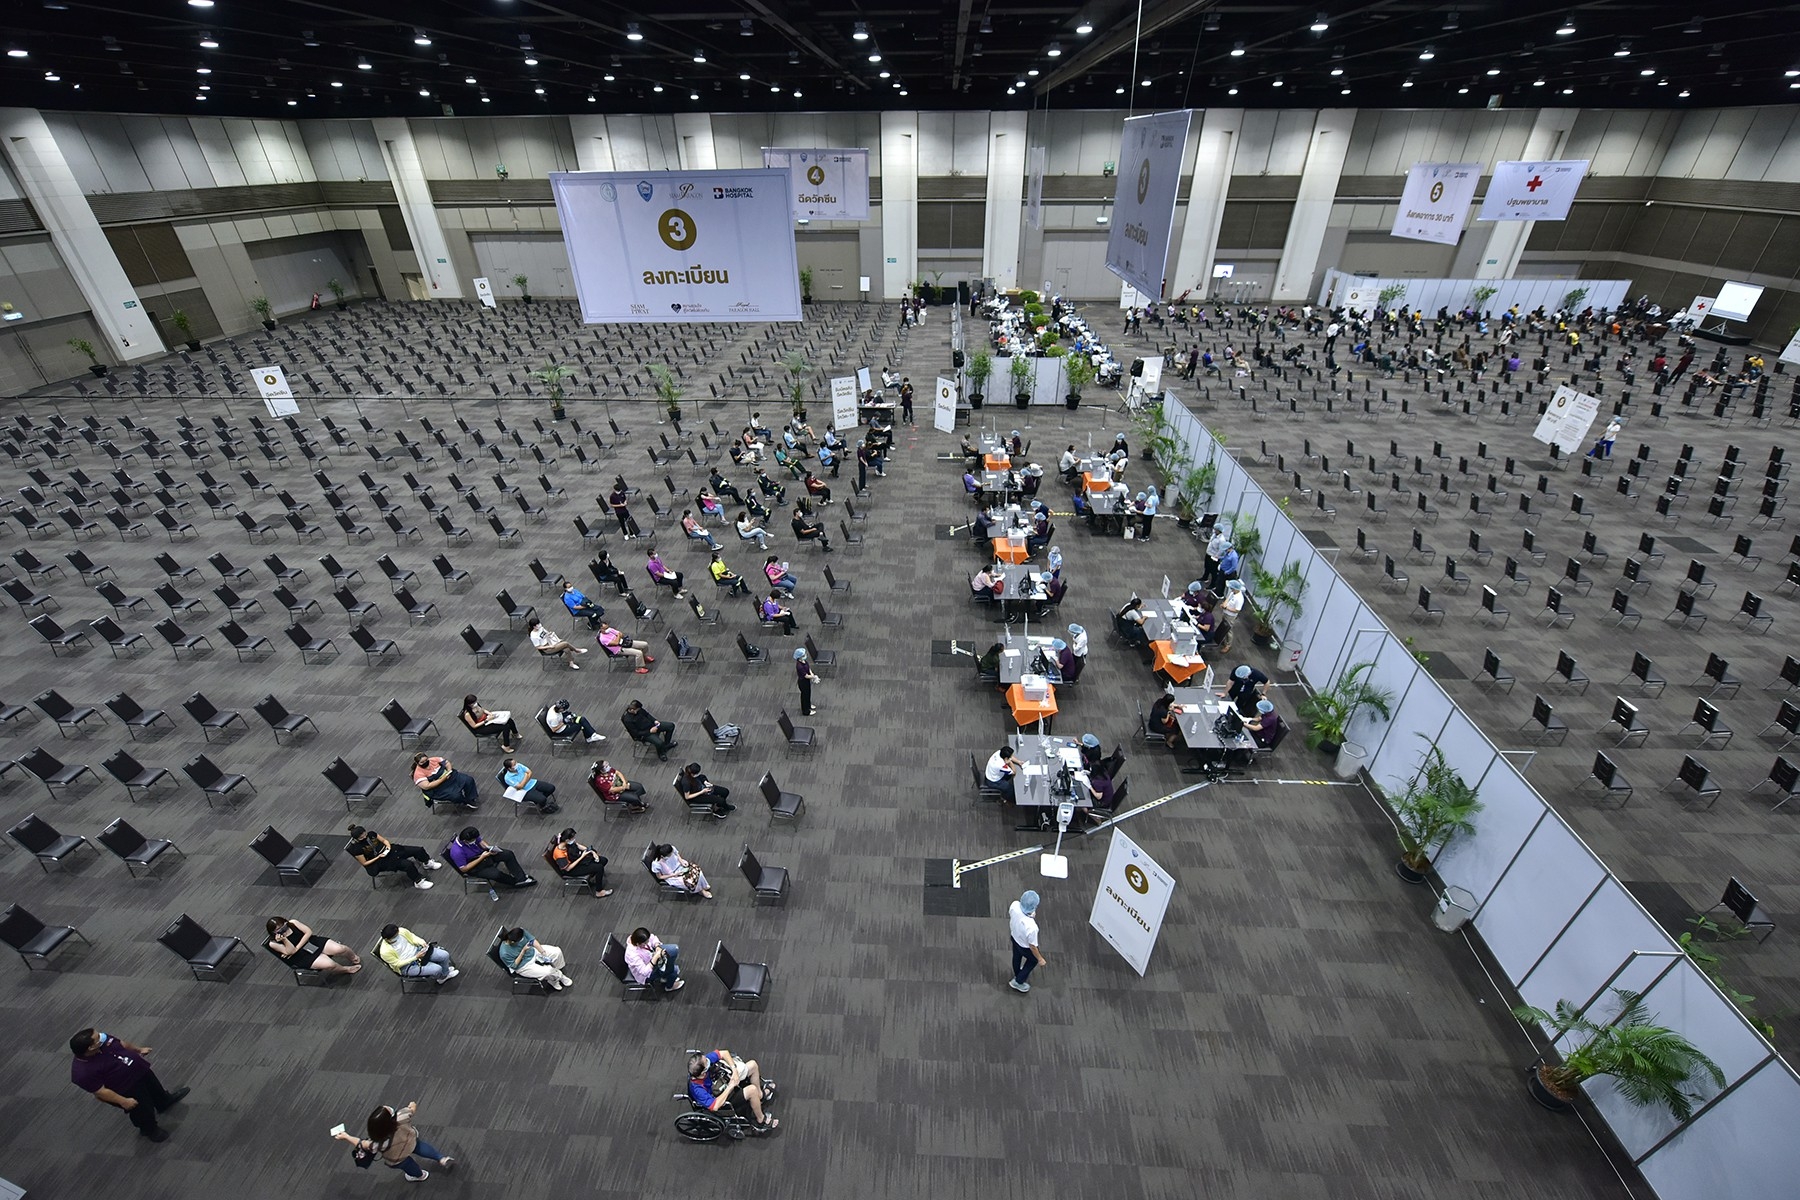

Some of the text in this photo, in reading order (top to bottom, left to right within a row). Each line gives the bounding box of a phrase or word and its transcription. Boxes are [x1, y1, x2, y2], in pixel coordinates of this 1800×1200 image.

[811, 168, 821, 182] 4
[1139, 171, 1147, 190] 3
[798, 194, 837, 204] ฉีดวัคซีน
[1433, 185, 1441, 199] 5
[1506, 198, 1549, 207] ปฐมพยาบาล
[668, 216, 687, 242] 3
[642, 264, 729, 285] ลงทะเบียน
[1130, 870, 1143, 888] 3
[1105, 884, 1151, 933] ลงทะเบียน
